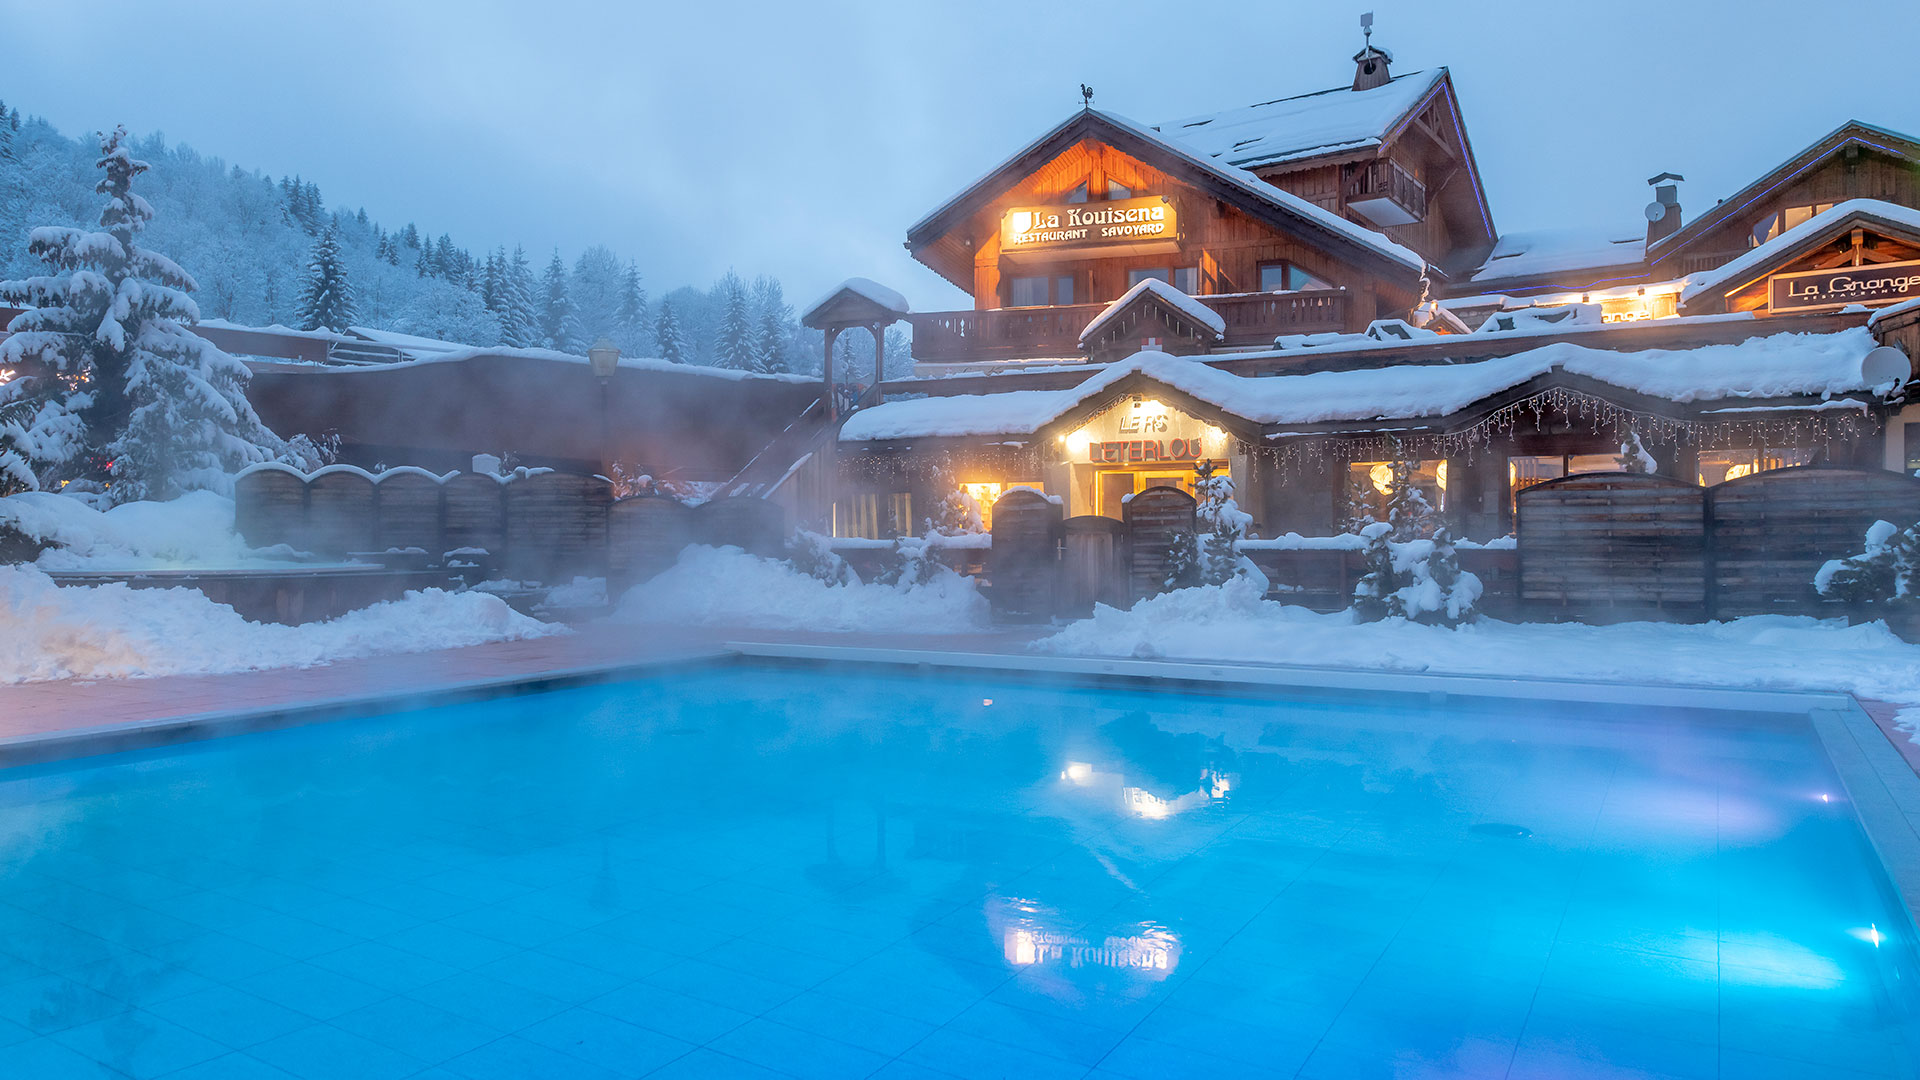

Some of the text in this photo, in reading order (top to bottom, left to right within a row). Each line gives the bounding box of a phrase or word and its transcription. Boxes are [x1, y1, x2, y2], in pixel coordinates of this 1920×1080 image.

[1034, 206, 1164, 229] La Kouisena
[1014, 223, 1165, 244] RESTAURANT SAVOYARD
[1788, 275, 1920, 297] La Grange
[1804, 288, 1898, 300] RESTAURANT
[1120, 415, 1140, 432] LE
